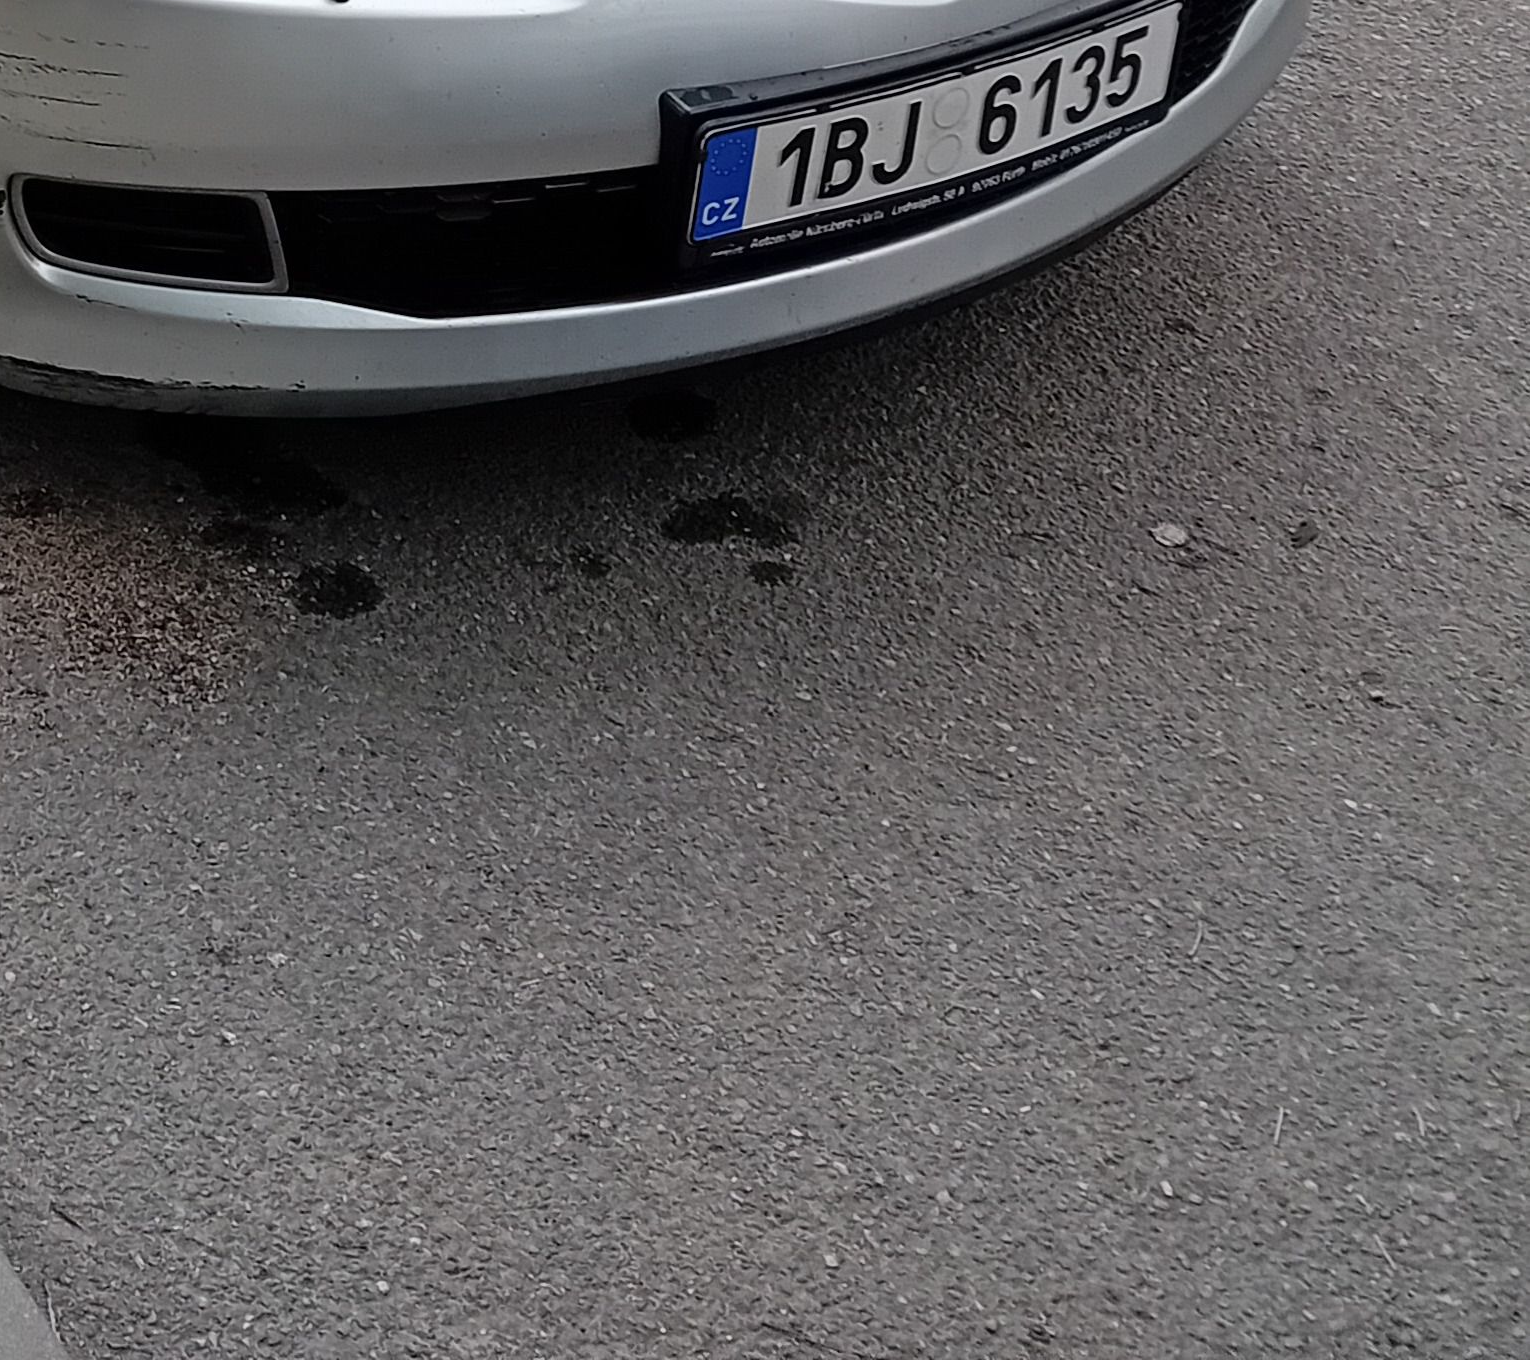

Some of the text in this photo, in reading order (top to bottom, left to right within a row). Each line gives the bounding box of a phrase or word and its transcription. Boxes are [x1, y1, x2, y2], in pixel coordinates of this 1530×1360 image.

[778, 25, 1150, 209] 1BJ 6135
[701, 196, 740, 226] CZ
